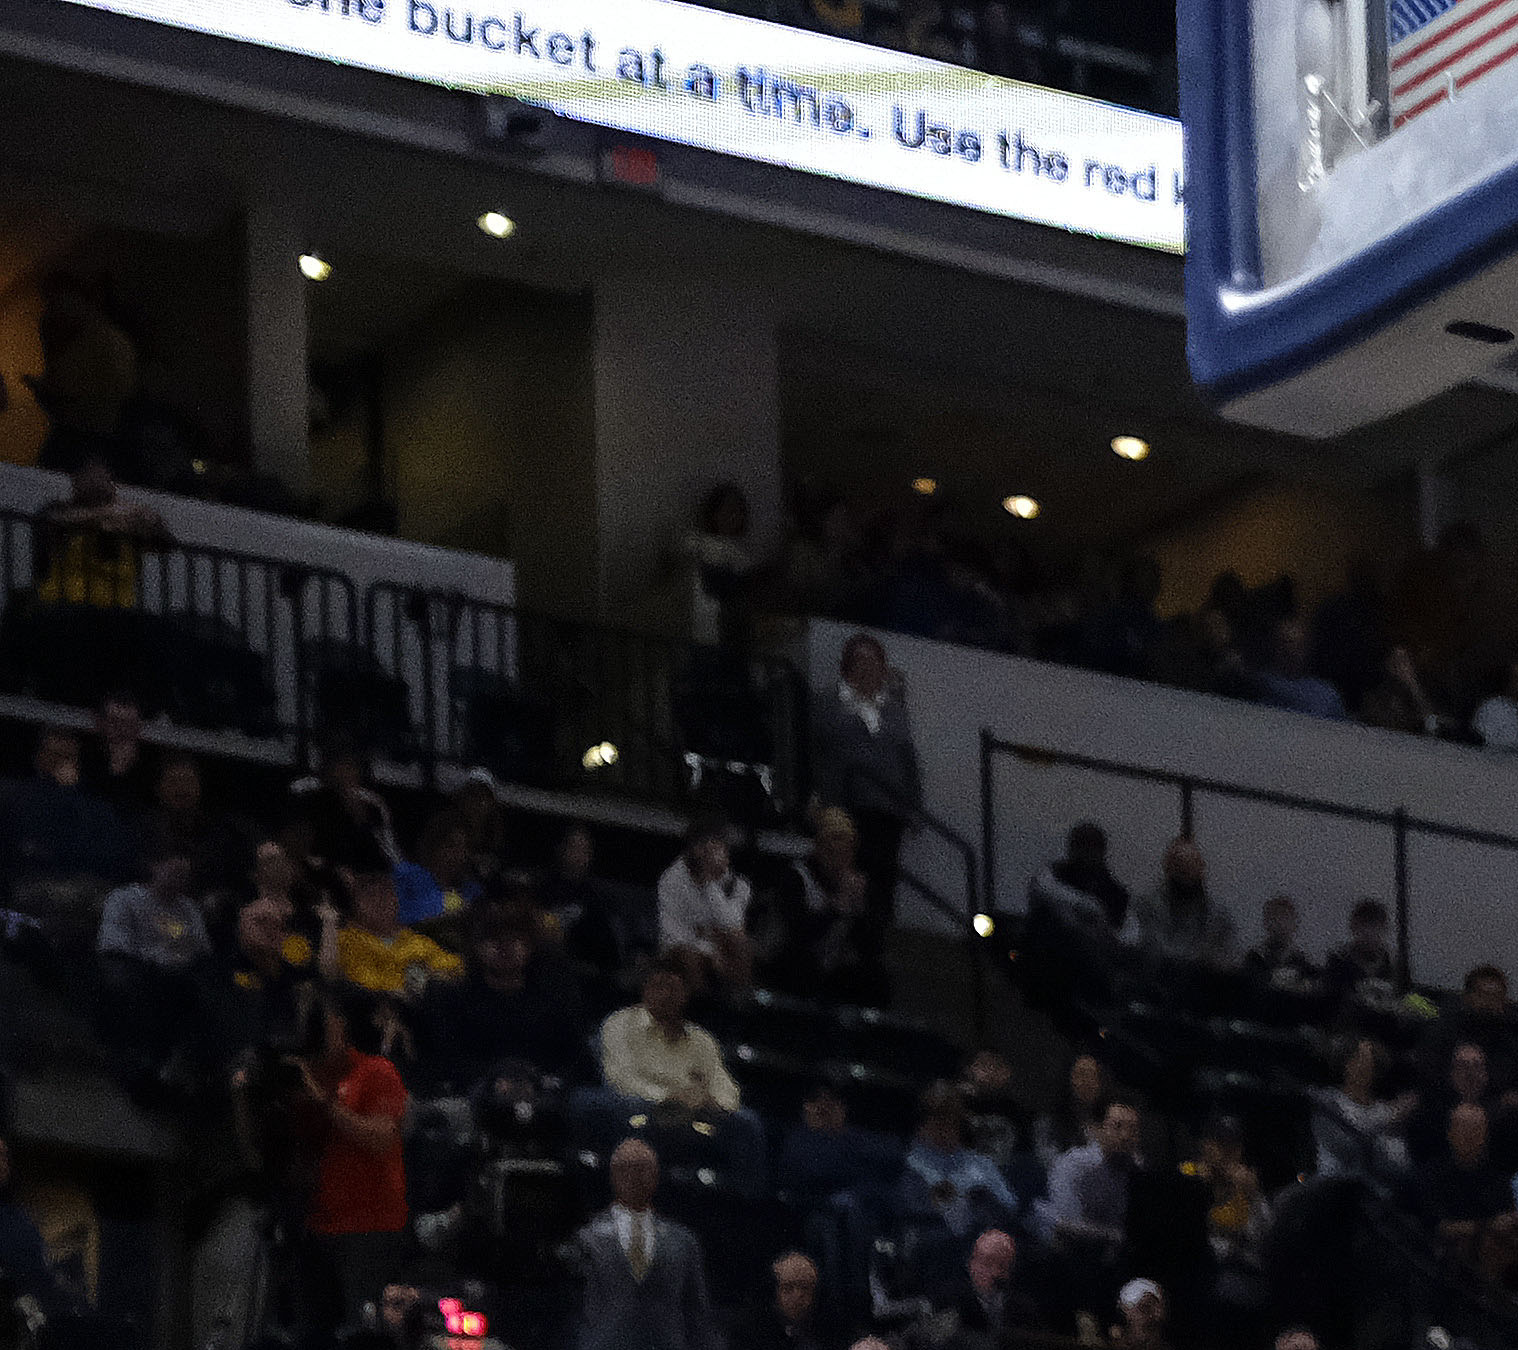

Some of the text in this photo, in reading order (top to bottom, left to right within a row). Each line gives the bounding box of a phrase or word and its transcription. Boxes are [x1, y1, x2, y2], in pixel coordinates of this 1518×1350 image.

[407, 0, 598, 73] bucket
[617, 45, 667, 90] at
[685, 63, 719, 100] a
[735, 66, 873, 139] time.
[894, 103, 986, 164] Use
[997, 127, 1070, 184] the
[1083, 151, 1158, 203] red
